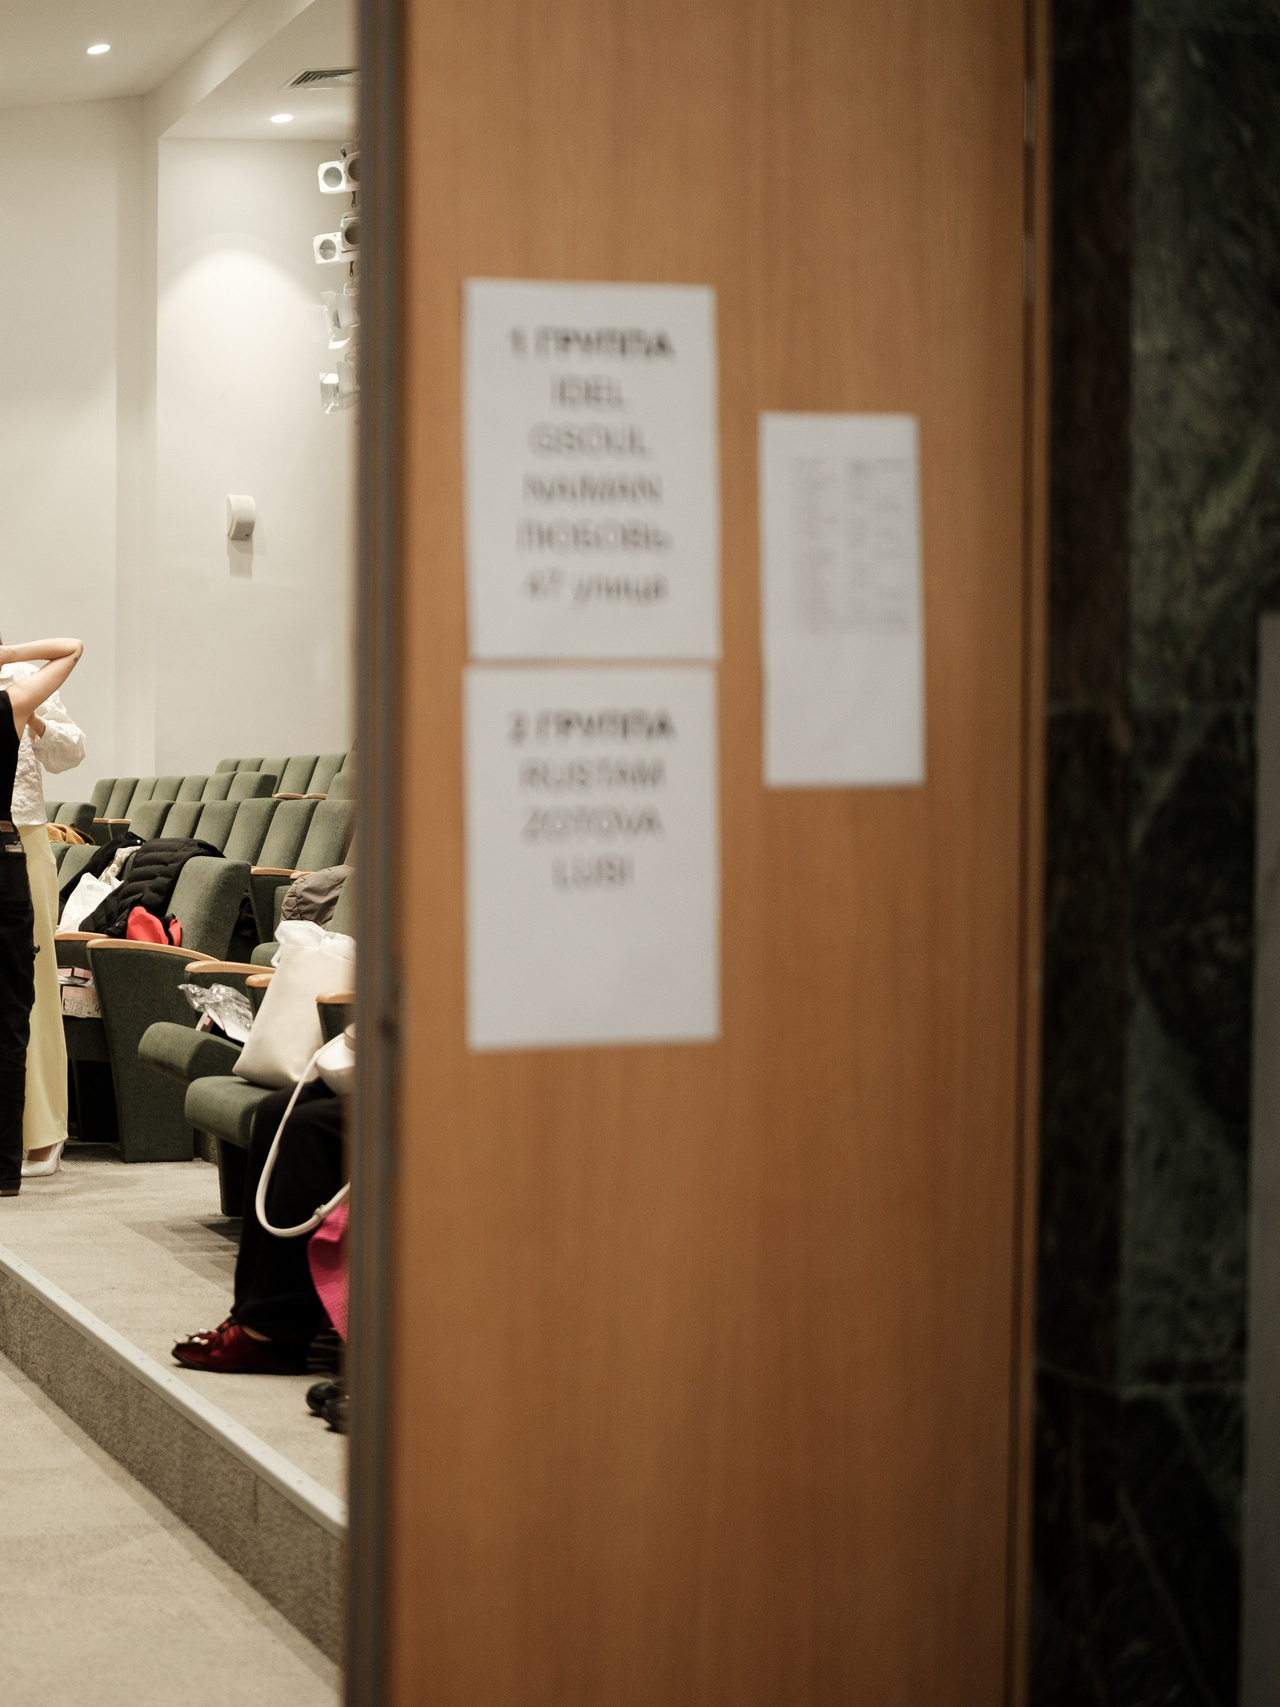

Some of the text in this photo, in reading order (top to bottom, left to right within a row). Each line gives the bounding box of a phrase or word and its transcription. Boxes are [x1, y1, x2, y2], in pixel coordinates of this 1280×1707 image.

[507, 328, 675, 361] 1 ГРУППА
[549, 374, 629, 411] IDEL
[518, 520, 673, 556] ЛЮБОВЬ
[507, 709, 677, 746] 2 ГРУППА
[520, 757, 665, 794] RUSTAM
[522, 805, 664, 843] ZOTOVA
